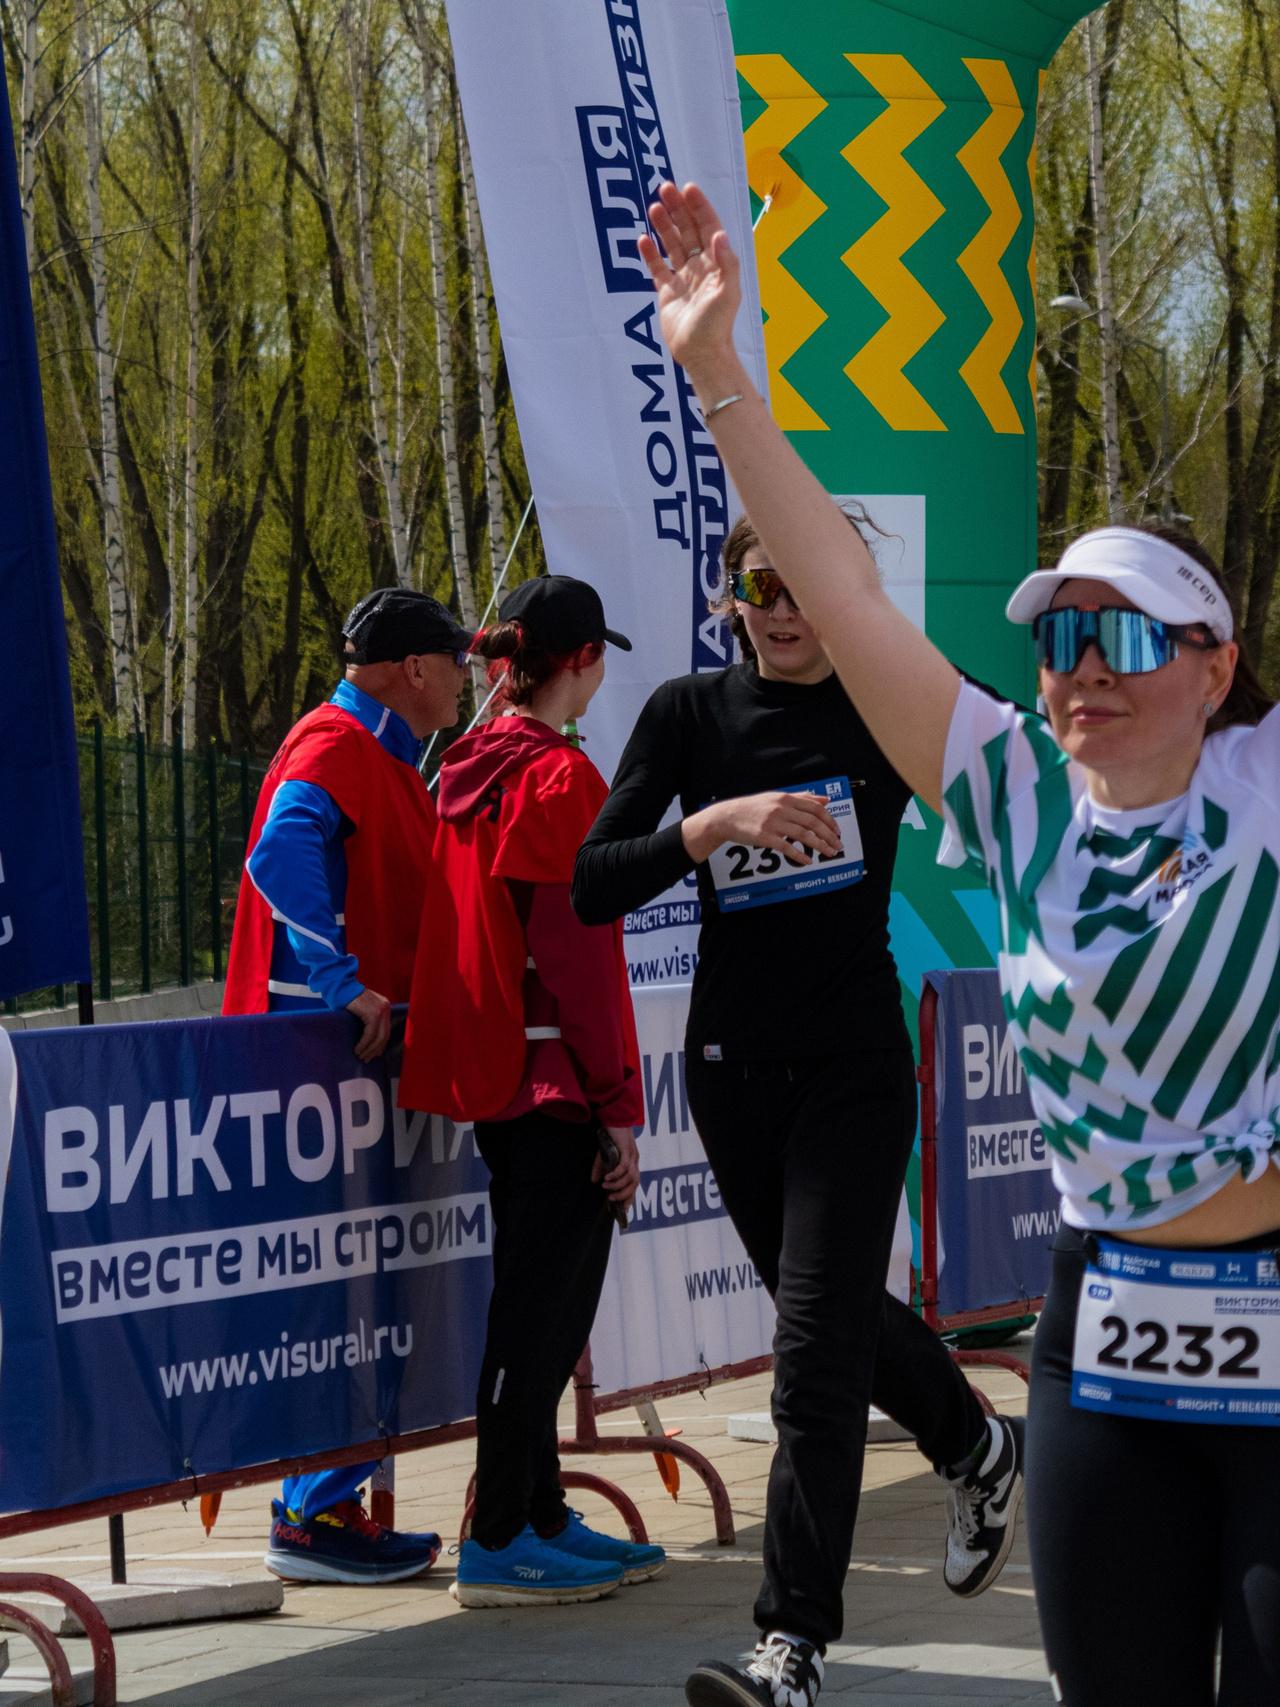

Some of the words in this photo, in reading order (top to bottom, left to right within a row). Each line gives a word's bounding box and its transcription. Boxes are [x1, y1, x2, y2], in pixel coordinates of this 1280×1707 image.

[587, 113, 658, 281] ДЛЯ
[624, 300, 692, 550] ДОМА
[333, 1203, 488, 1273] строим
[158, 1317, 414, 1399] www.visural.ru
[1097, 1315, 1260, 1380] 2232
[273, 1522, 312, 1547] HOKA
